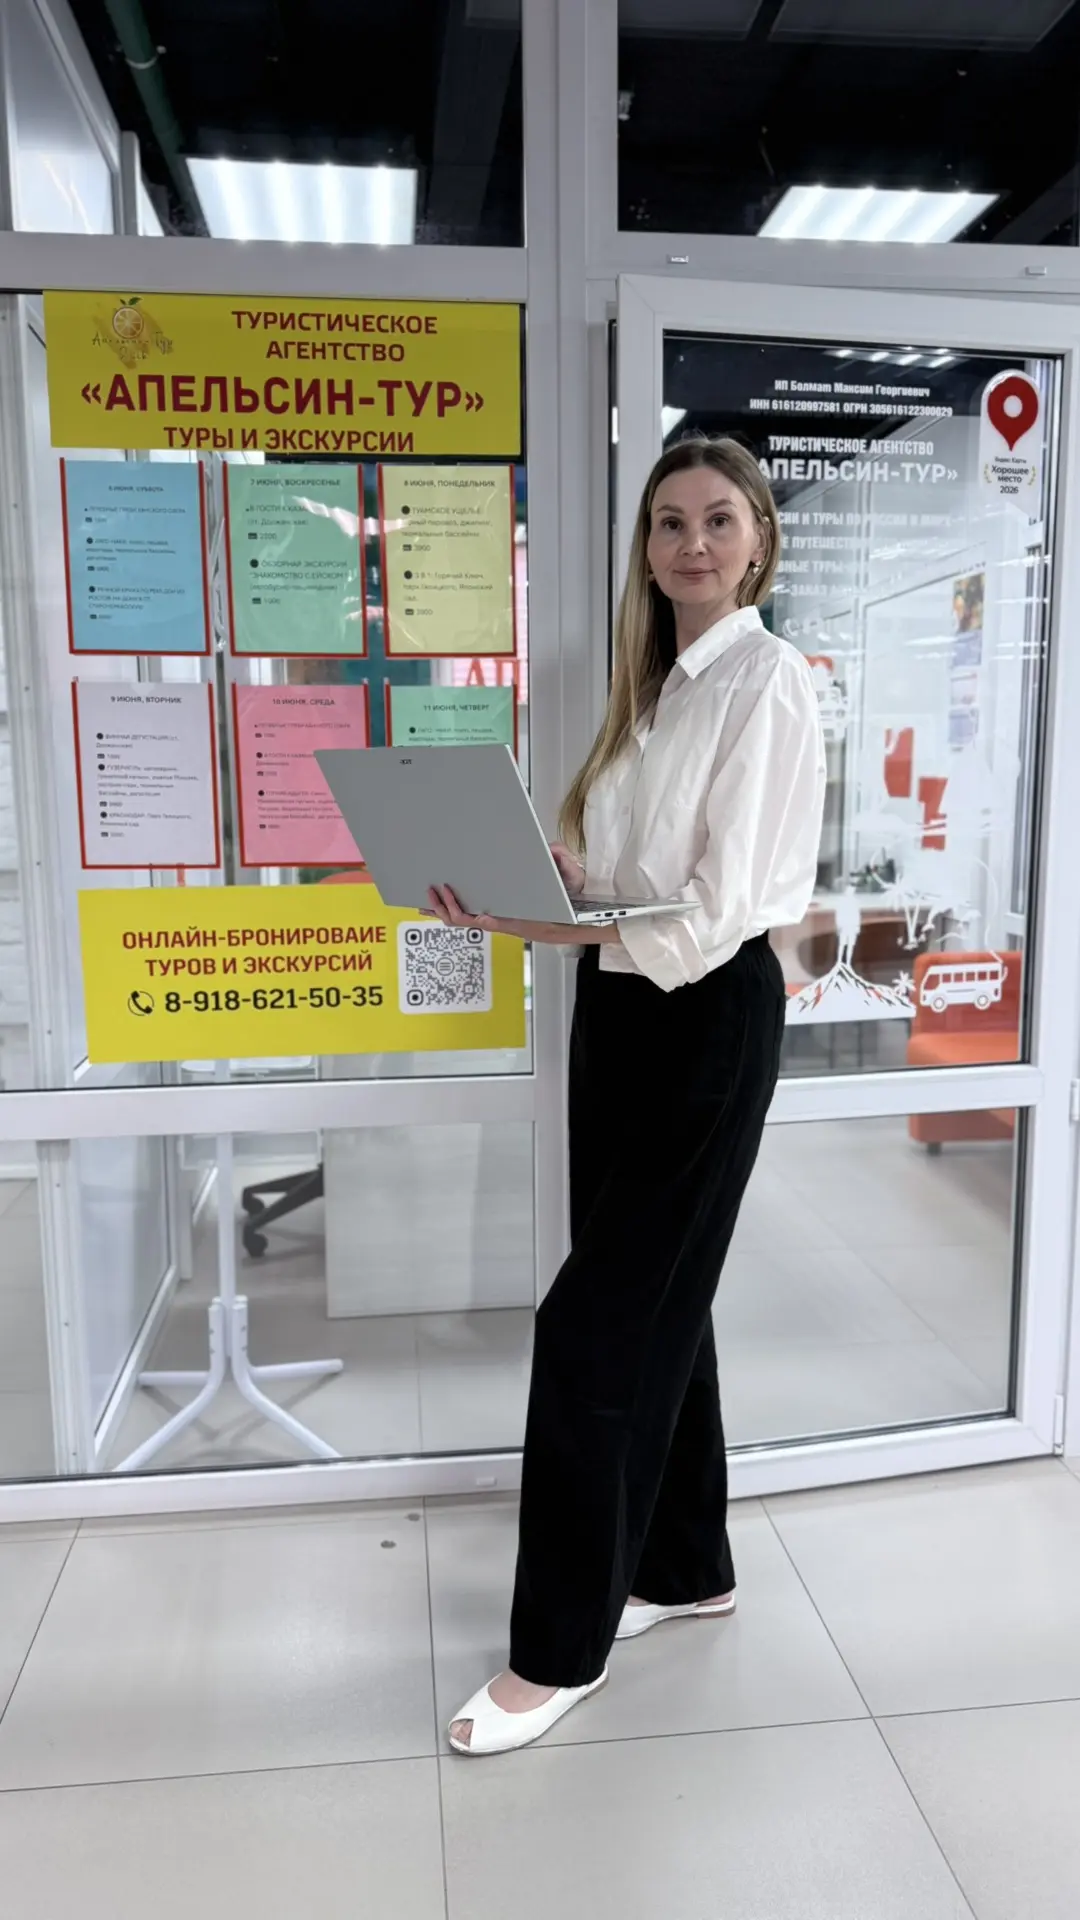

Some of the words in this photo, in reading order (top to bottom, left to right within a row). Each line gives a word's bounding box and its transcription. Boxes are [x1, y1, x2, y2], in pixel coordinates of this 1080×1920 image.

[231, 311, 438, 334] ТУРИСТИЧЕСКОЕ
[265, 341, 405, 362] АГЕНТСТВО
[80, 373, 485, 418] «АПЕЛЬСИН-ТУР»
[774, 379, 788, 391] ИП
[834, 382, 873, 394] Максим
[875, 384, 930, 398] Георгиевич
[749, 398, 770, 410] ИНН
[843, 402, 868, 414] ОГРН
[163, 427, 234, 449] ТУРЫ
[241, 429, 258, 449] И
[264, 429, 415, 452] ЭКСКУРСИИ
[768, 436, 867, 453] ТУРИСТИЧЕСКОЕ
[869, 439, 934, 456] АГЕНТСТВО
[991, 464, 1030, 475] Хорошее
[997, 475, 1023, 483] место
[437, 480, 496, 488] ПОНЕДЕЛЬНИК
[1000, 485, 1019, 494] 2026
[813, 512, 843, 526] ТУРЫ
[117, 696, 144, 704] ИЮНЯ,
[146, 696, 183, 704] ВТОРНИК
[122, 925, 387, 951] ОНЛАЙН-БРОНИРОВАИЕ
[144, 957, 216, 977] ТУРОВ
[222, 957, 238, 976] И
[243, 949, 373, 975] ЭКСКУРСИЙ
[164, 985, 384, 1014] 8-918-621-50-35
